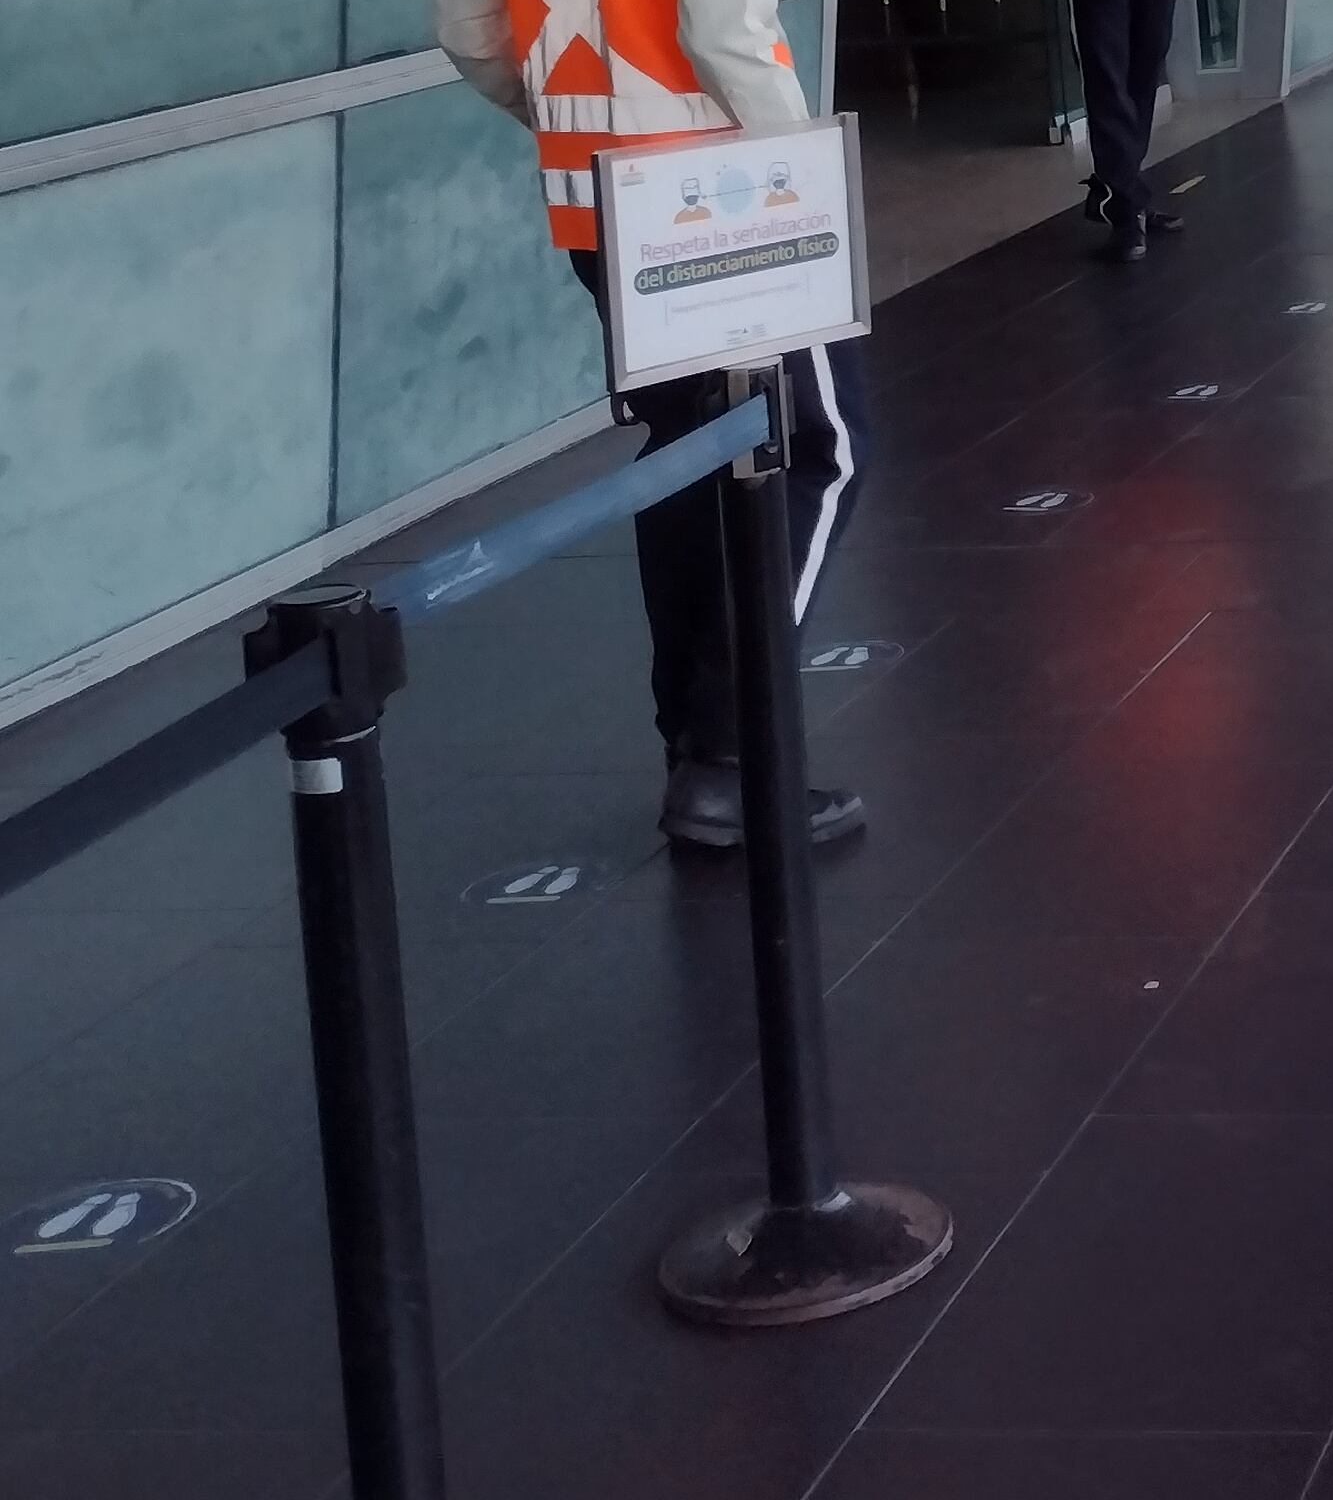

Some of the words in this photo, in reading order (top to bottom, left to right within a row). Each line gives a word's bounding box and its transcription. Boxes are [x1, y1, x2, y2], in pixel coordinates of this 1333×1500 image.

[640, 236, 711, 262] Respeta
[714, 230, 729, 248] la
[732, 211, 831, 244] señalización
[636, 269, 664, 290] del
[666, 245, 796, 284] distanciamiento
